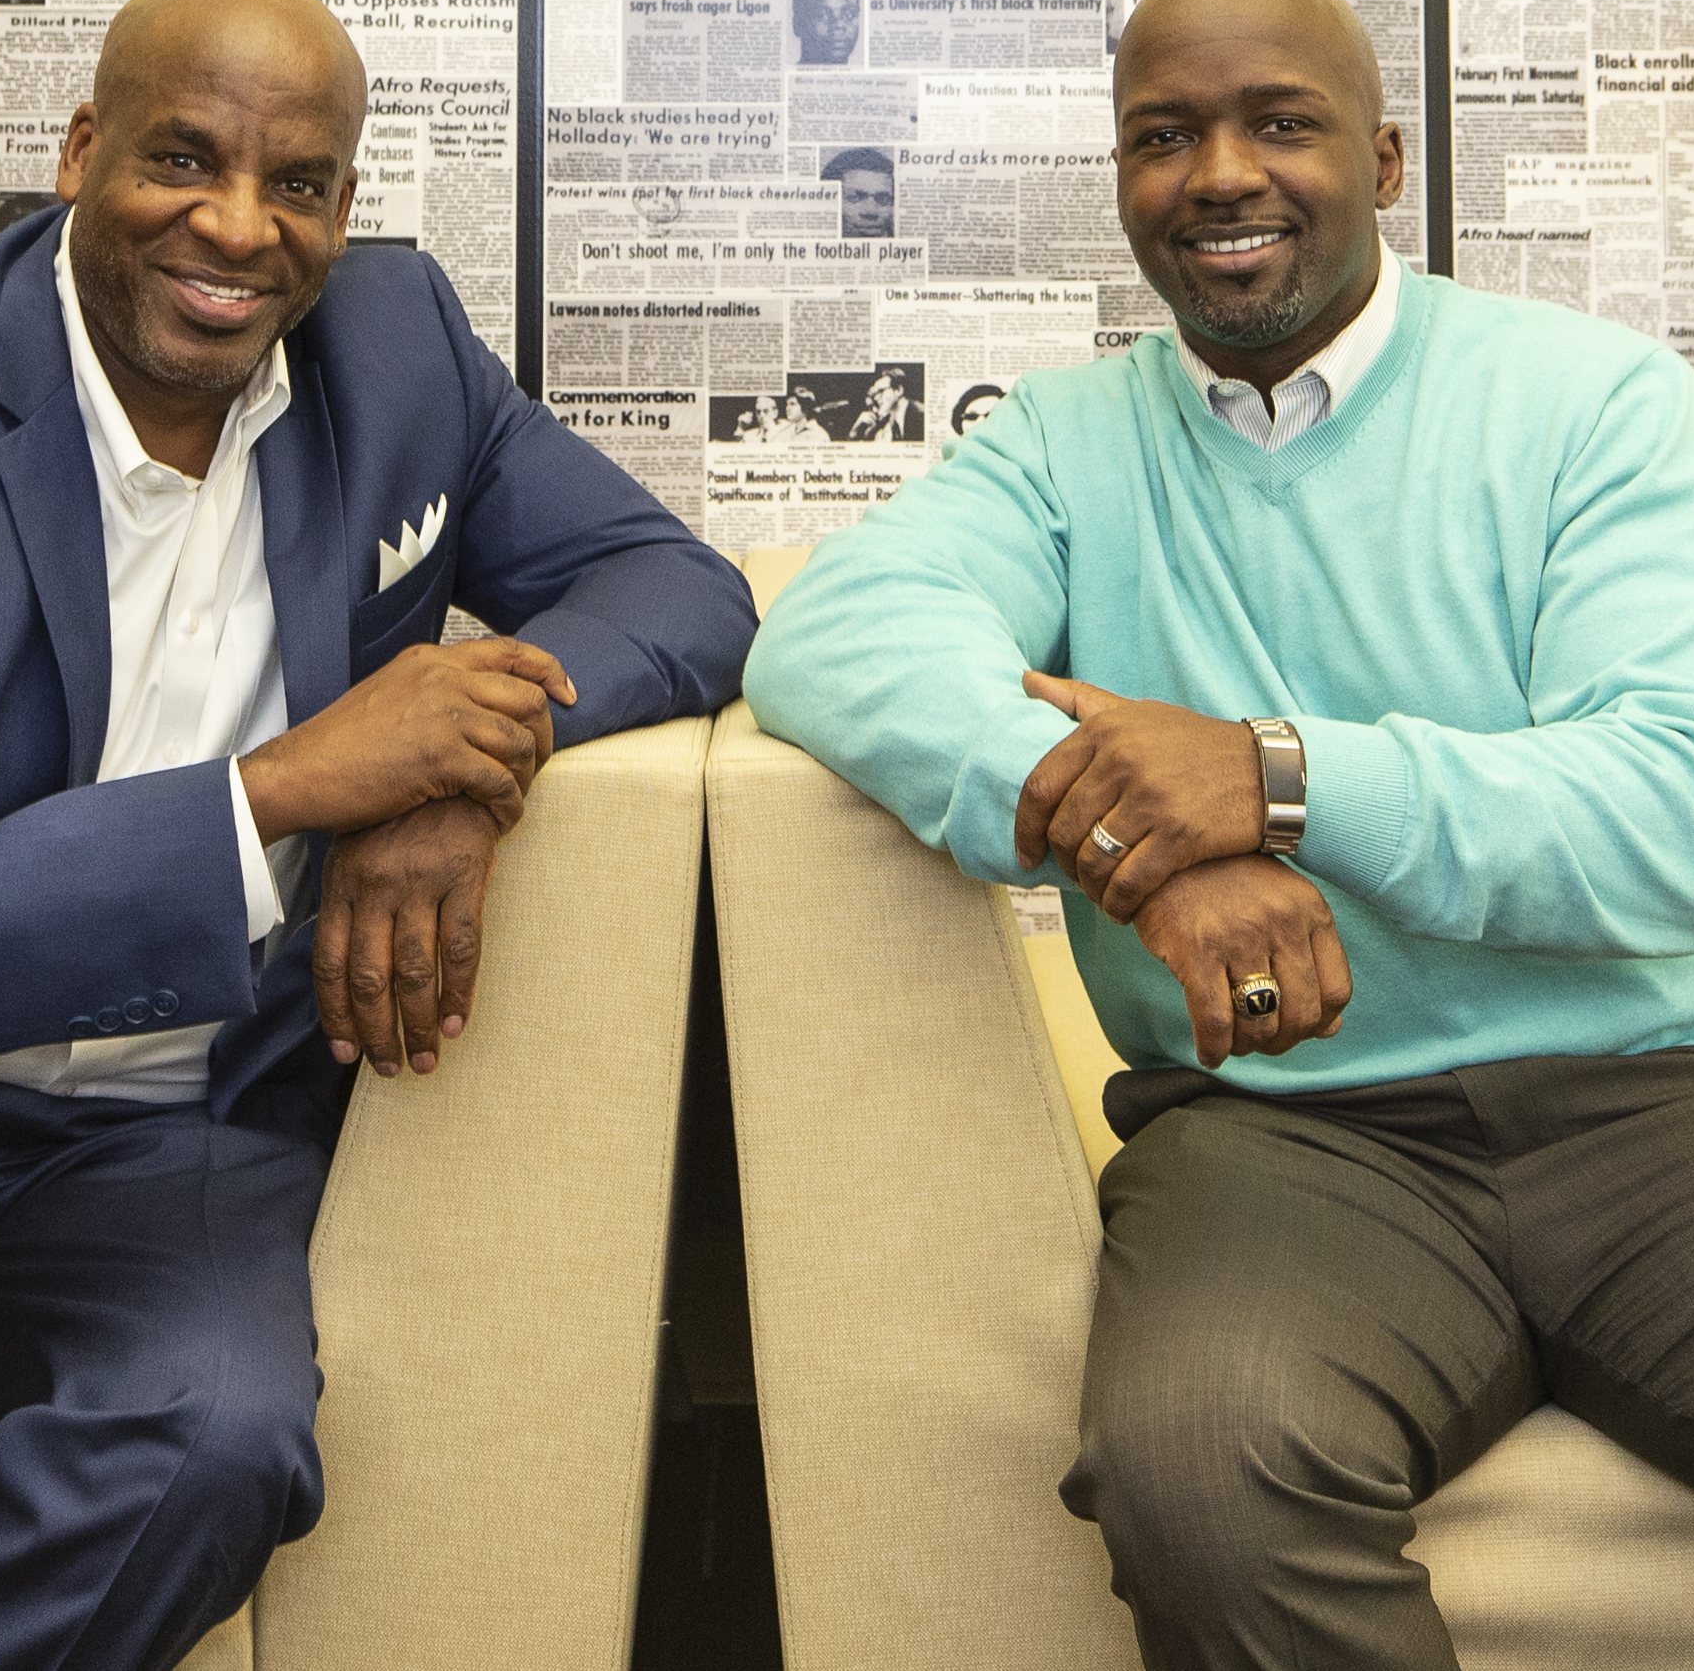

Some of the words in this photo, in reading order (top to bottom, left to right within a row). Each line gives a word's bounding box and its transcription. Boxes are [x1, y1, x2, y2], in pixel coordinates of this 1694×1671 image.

[1594, 54, 1637, 70] Black
[369, 77, 414, 94] Afro
[419, 78, 511, 98] Requests,
[1596, 76, 1666, 93] financial
[547, 108, 573, 124] No
[576, 108, 625, 125] black
[630, 108, 691, 125] studies
[695, 108, 742, 125] head
[1457, 228, 1493, 241] Afro
[1495, 229, 1536, 242] head
[1537, 230, 1592, 242] named
[581, 243, 621, 260] Don't
[628, 243, 669, 260] shoot
[744, 243, 775, 263] only
[782, 243, 807, 260] the
[814, 243, 871, 260] football
[878, 243, 923, 264] player
[549, 302, 601, 318] Lawson
[602, 304, 641, 318] notes
[642, 302, 704, 318] distorted
[706, 302, 761, 318] realities
[548, 391, 697, 405] Commemoration
